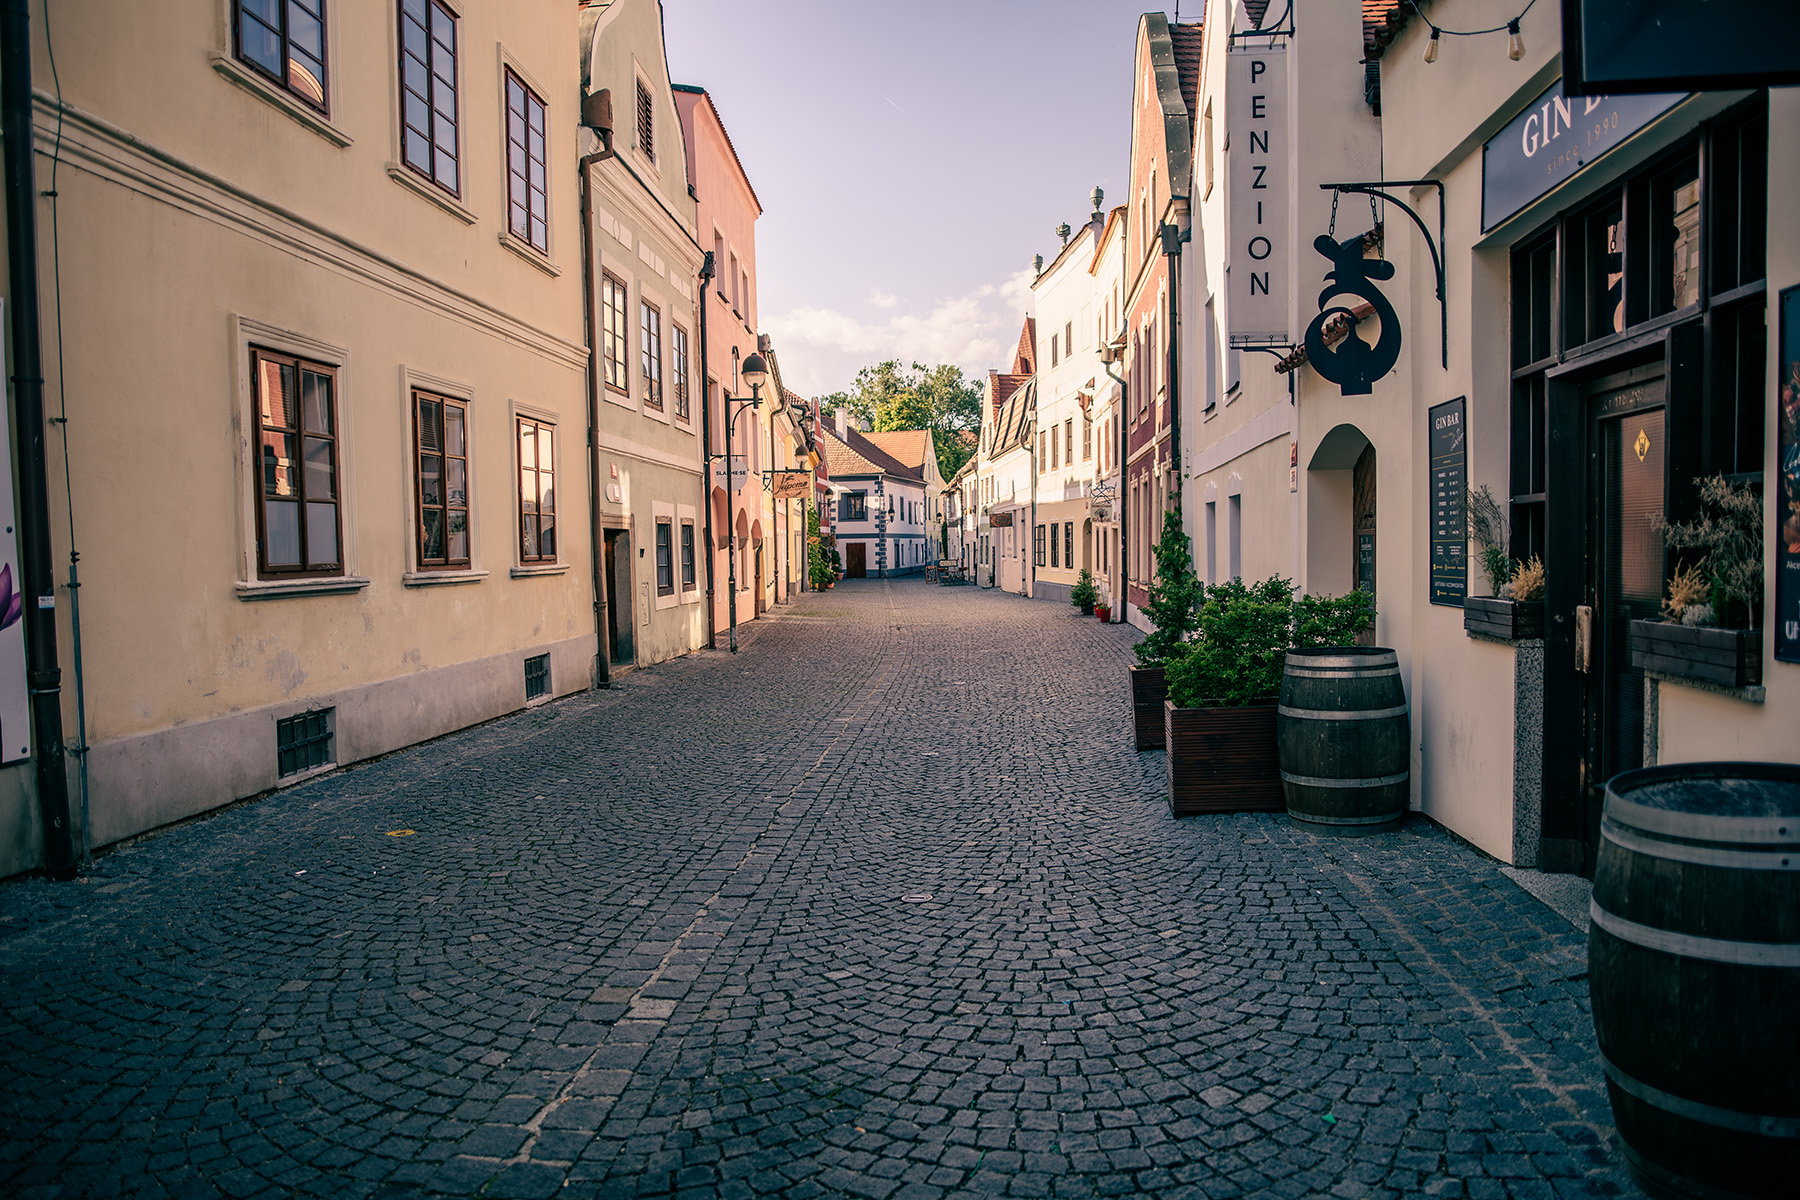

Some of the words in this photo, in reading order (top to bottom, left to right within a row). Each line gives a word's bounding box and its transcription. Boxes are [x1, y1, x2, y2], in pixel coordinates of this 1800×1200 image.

[1521, 94, 1572, 158] GIN
[1547, 143, 1579, 175] since
[1586, 111, 1619, 147] 1990
[1247, 60, 1272, 296] PENZION
[1435, 415, 1447, 430] GIN
[1447, 412, 1460, 427] BAR
